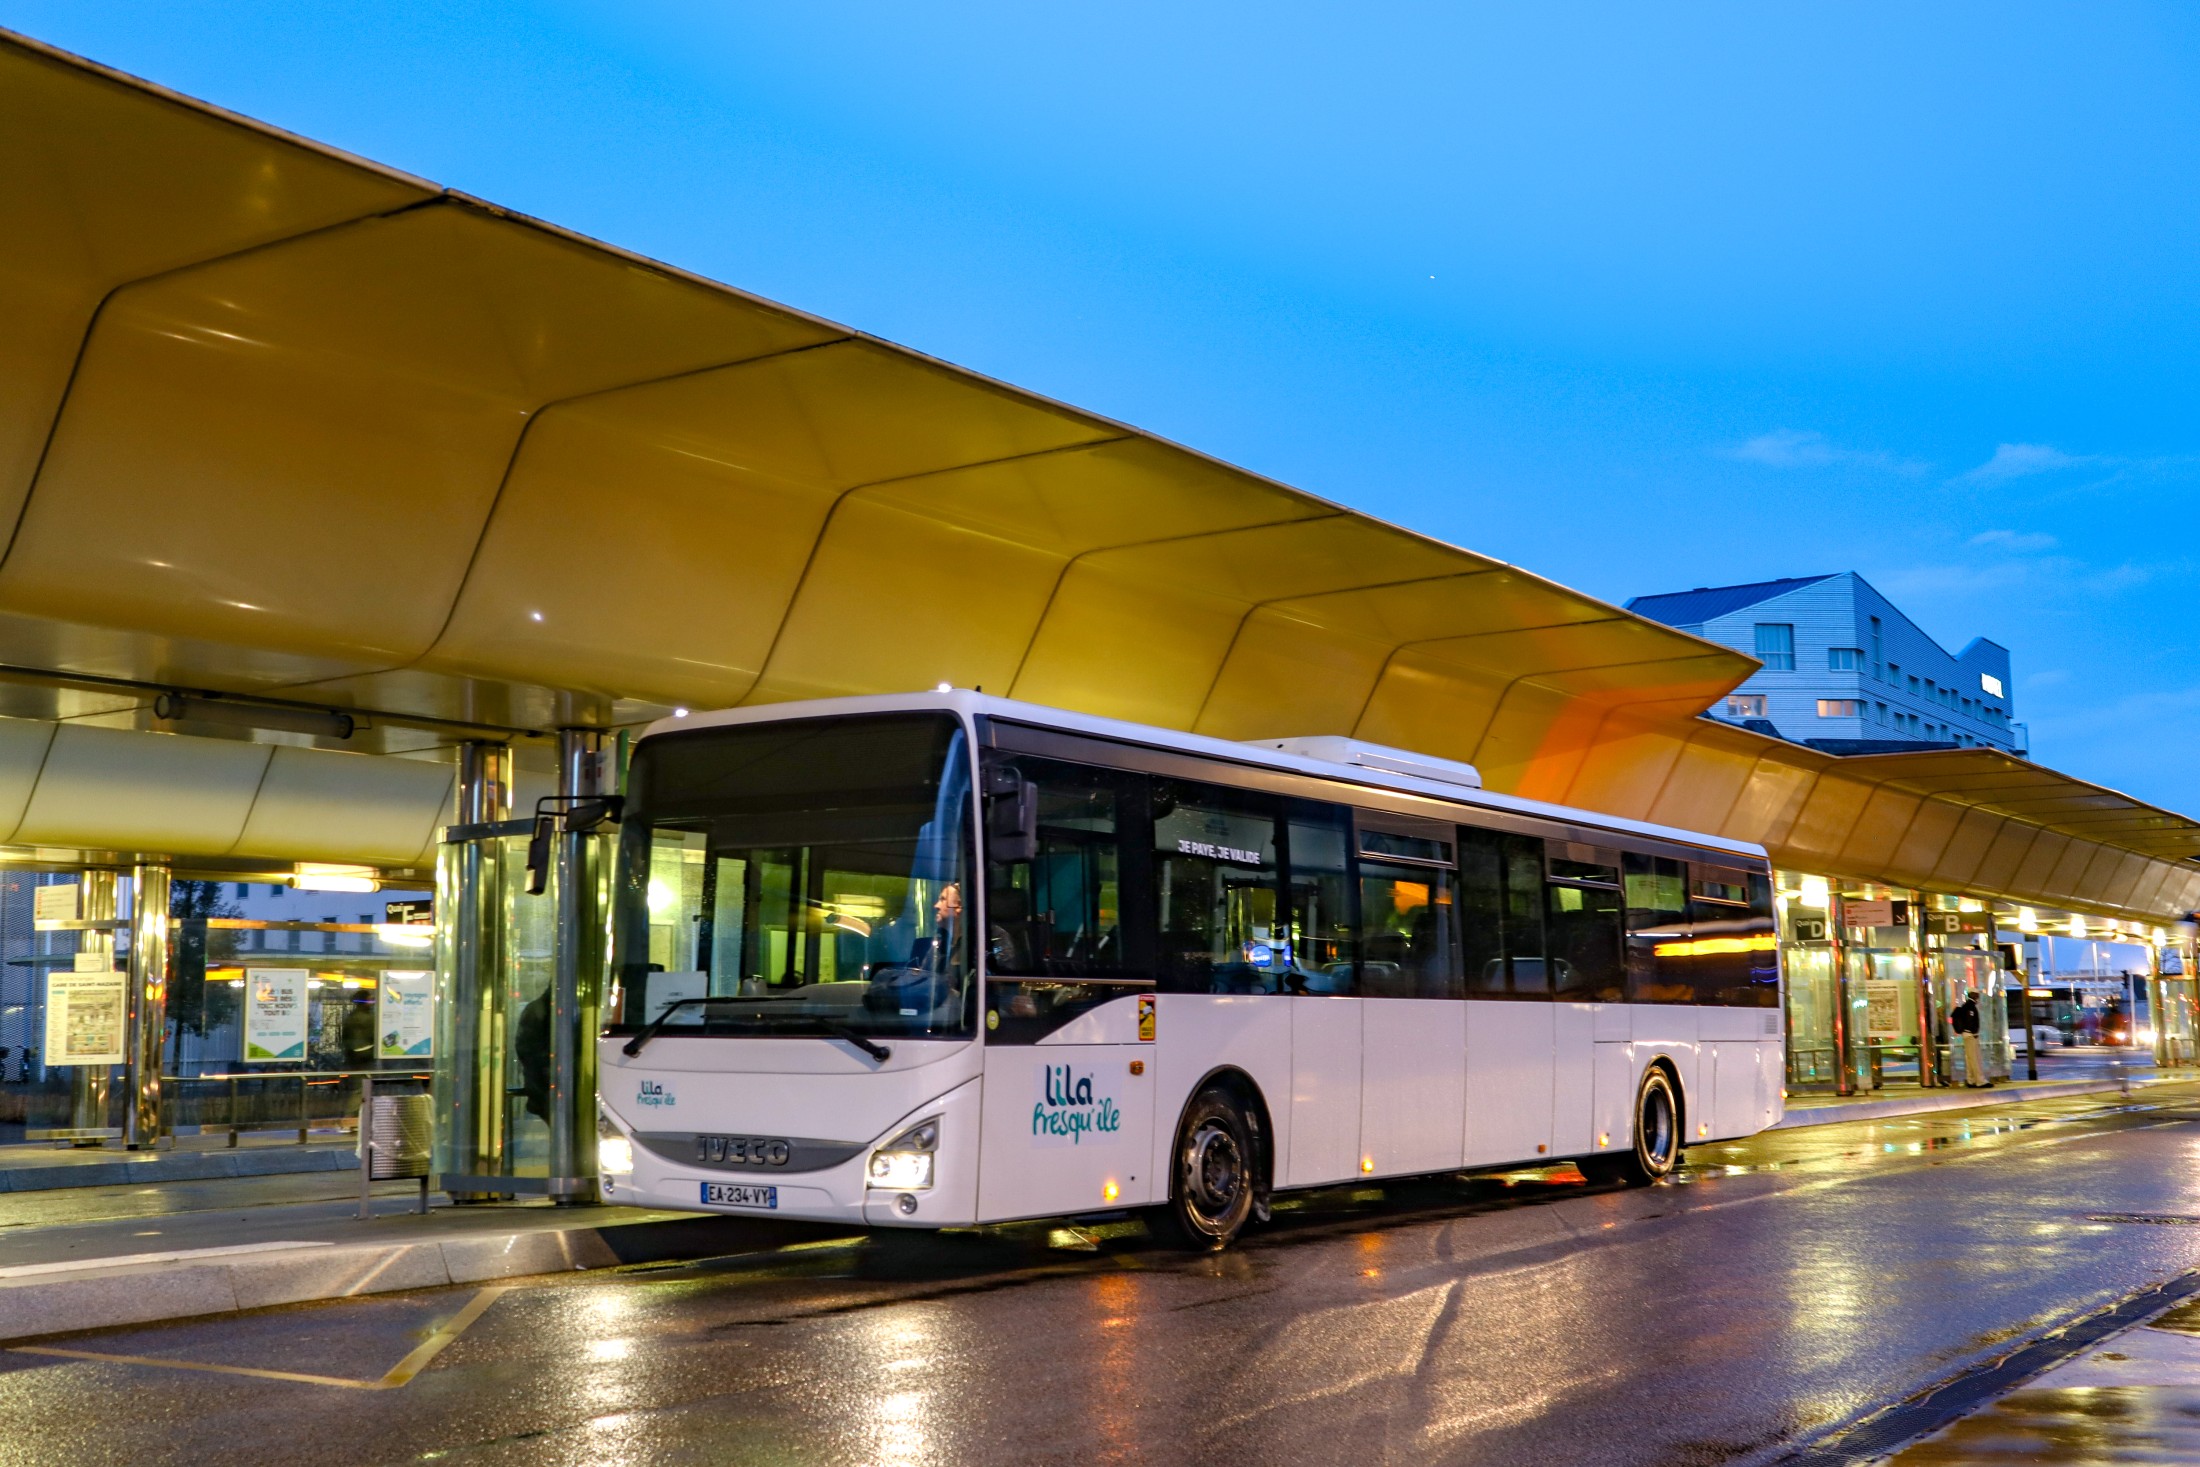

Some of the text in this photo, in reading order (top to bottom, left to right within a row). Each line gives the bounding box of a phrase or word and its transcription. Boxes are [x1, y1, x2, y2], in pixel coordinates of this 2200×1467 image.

[1178, 840, 1261, 865] JE PAYE, JE VALIDE
[386, 902, 403, 914] Quai
[1796, 919, 1824, 938] Quai D
[1927, 913, 1961, 932] Quai B
[697, 1136, 790, 1166] IVECO
[708, 1186, 769, 1205] EA-234-VY
